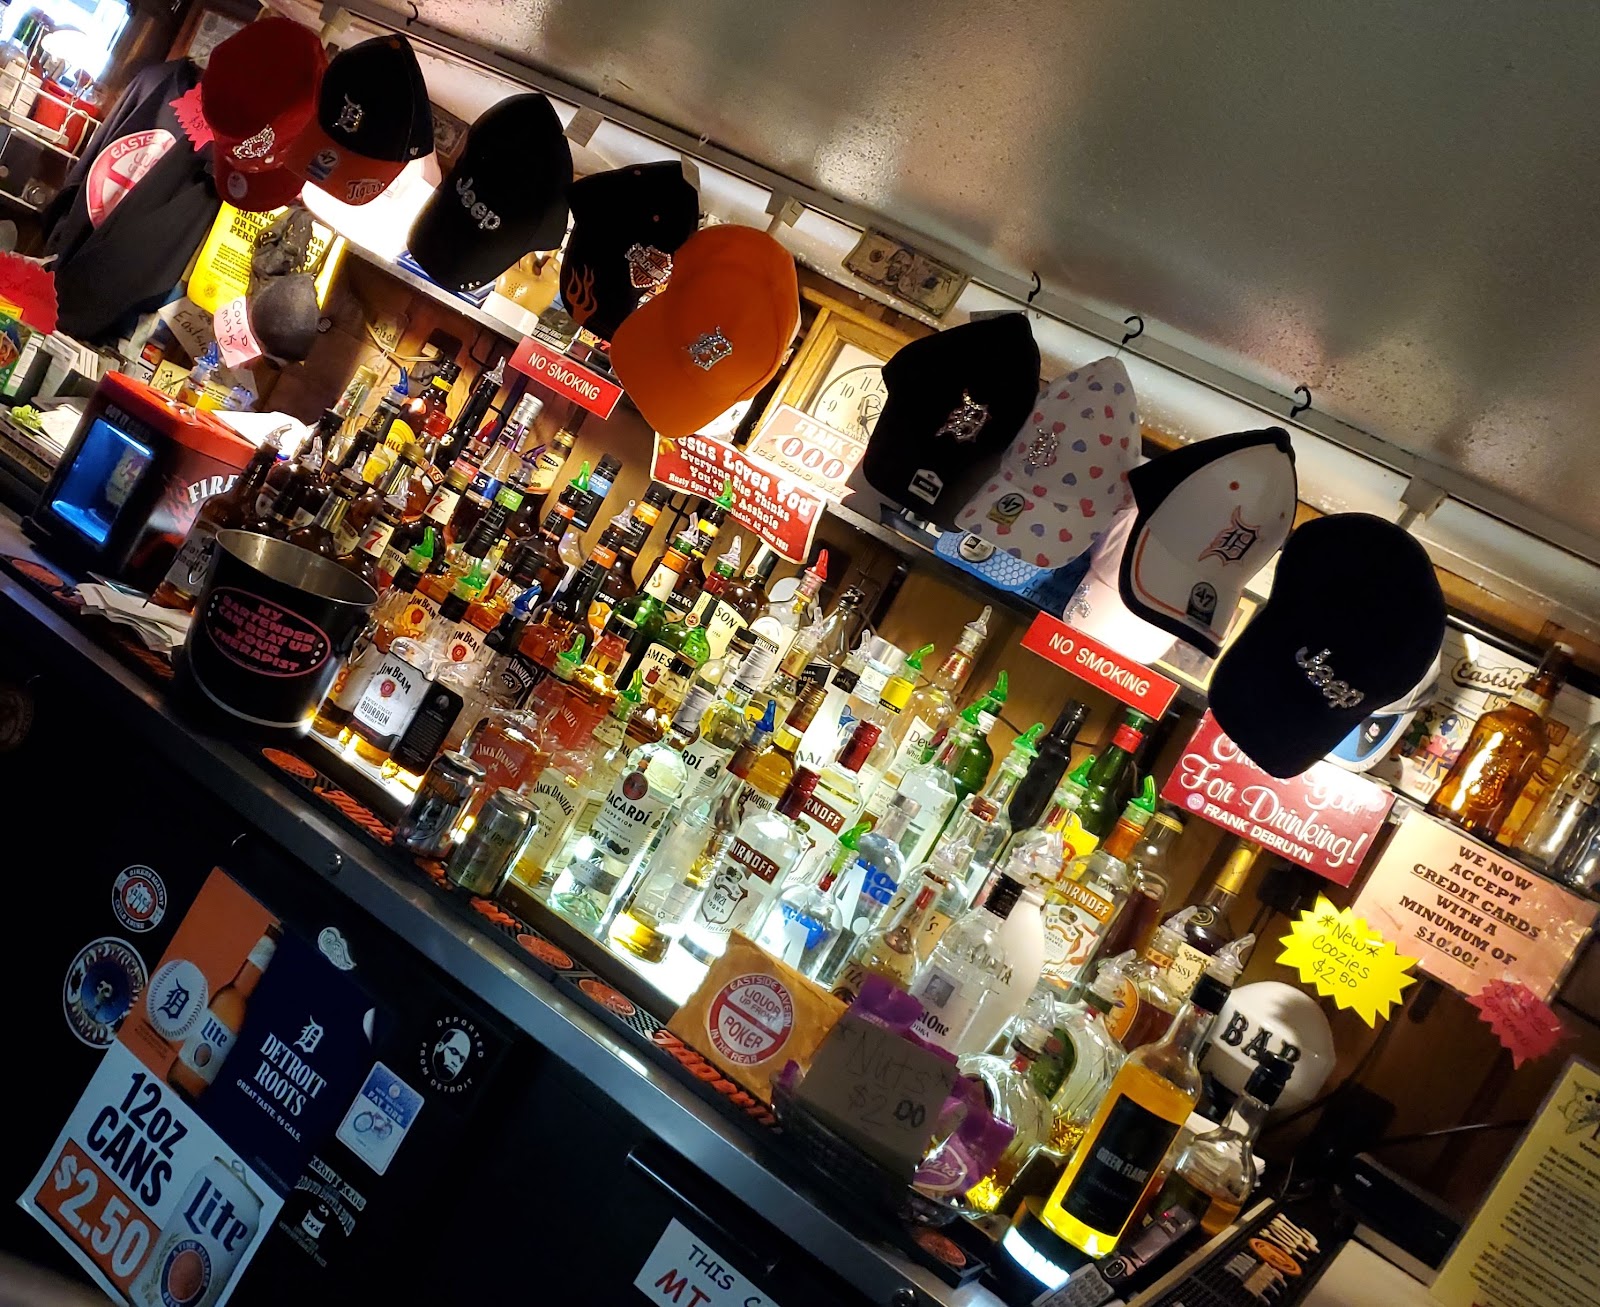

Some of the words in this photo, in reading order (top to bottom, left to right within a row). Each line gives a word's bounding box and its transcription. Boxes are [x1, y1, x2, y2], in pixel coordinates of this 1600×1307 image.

[456, 177, 501, 230] Jeep
[229, 225, 255, 243] PERS
[528, 352, 547, 370] NO
[547, 363, 600, 401] SMOKING
[678, 434, 717, 462] esus
[723, 453, 771, 492] Loves
[776, 480, 811, 517] You
[783, 438, 843, 478] BAR
[187, 474, 240, 504] FIRE
[681, 450, 731, 480] Everyone
[754, 492, 790, 521] Thinks
[738, 498, 779, 530] Asshole
[365, 530, 383, 551] 7
[218, 605, 244, 628] CAN
[245, 622, 287, 646] BEAT
[288, 640, 313, 653] UP
[222, 595, 317, 644] BARTENDER
[258, 604, 283, 621] MY
[214, 626, 299, 671] THERAPIST
[235, 629, 281, 656] YOUR
[378, 662, 393, 678] JIM
[391, 669, 411, 695] BEAM
[1048, 632, 1074, 655] NO
[1075, 648, 1150, 697] SMOKING
[1295, 647, 1364, 708] Jeep
[360, 700, 390, 726] BOURBON
[533, 781, 551, 796] JACK
[551, 785, 575, 816] DANIEL'S
[804, 798, 841, 827] RNOFF
[1181, 753, 1236, 804] For
[1241, 785, 1369, 867] Drinking!
[1203, 802, 1252, 832] FRANK
[1250, 825, 1314, 863] DEBRUYN
[1448, 862, 1521, 905] ACCEPT
[1459, 846, 1485, 868] WE
[1487, 861, 1533, 891] NOW
[707, 900, 725, 915] VODKA
[1413, 863, 1480, 904] CREDIT
[1480, 899, 1541, 938] CARDS
[1436, 894, 1483, 928] WITH
[1483, 922, 1498, 937] A
[1399, 896, 1490, 951] MINUMUM
[1491, 947, 1519, 966] OF
[1416, 926, 1480, 967] $10.00!
[1312, 934, 1370, 979] Coozies
[1313, 959, 1357, 988] $2.50
[730, 976, 778, 991] EASTSIDE
[777, 987, 792, 1028] TAVERN
[739, 995, 751, 1009] UP
[750, 1004, 777, 1023] FRONT
[744, 988, 781, 1018] LIQUOR
[201, 1017, 227, 1047] Lite
[437, 1016, 484, 1058] DEPORTED
[710, 1029, 719, 1039] IN
[717, 1040, 732, 1058] THE
[730, 1052, 758, 1065] REAR
[724, 1015, 763, 1049] POKER
[260, 1032, 327, 1099] DETROIT
[430, 1078, 473, 1093] DETROIT
[236, 1079, 256, 1098] GREAT
[253, 1060, 307, 1117] ROOTS
[86, 1105, 173, 1207] CANS
[54, 1154, 150, 1278] $2.50
[183, 1176, 248, 1253] Lite
[688, 1244, 735, 1290] THIS
